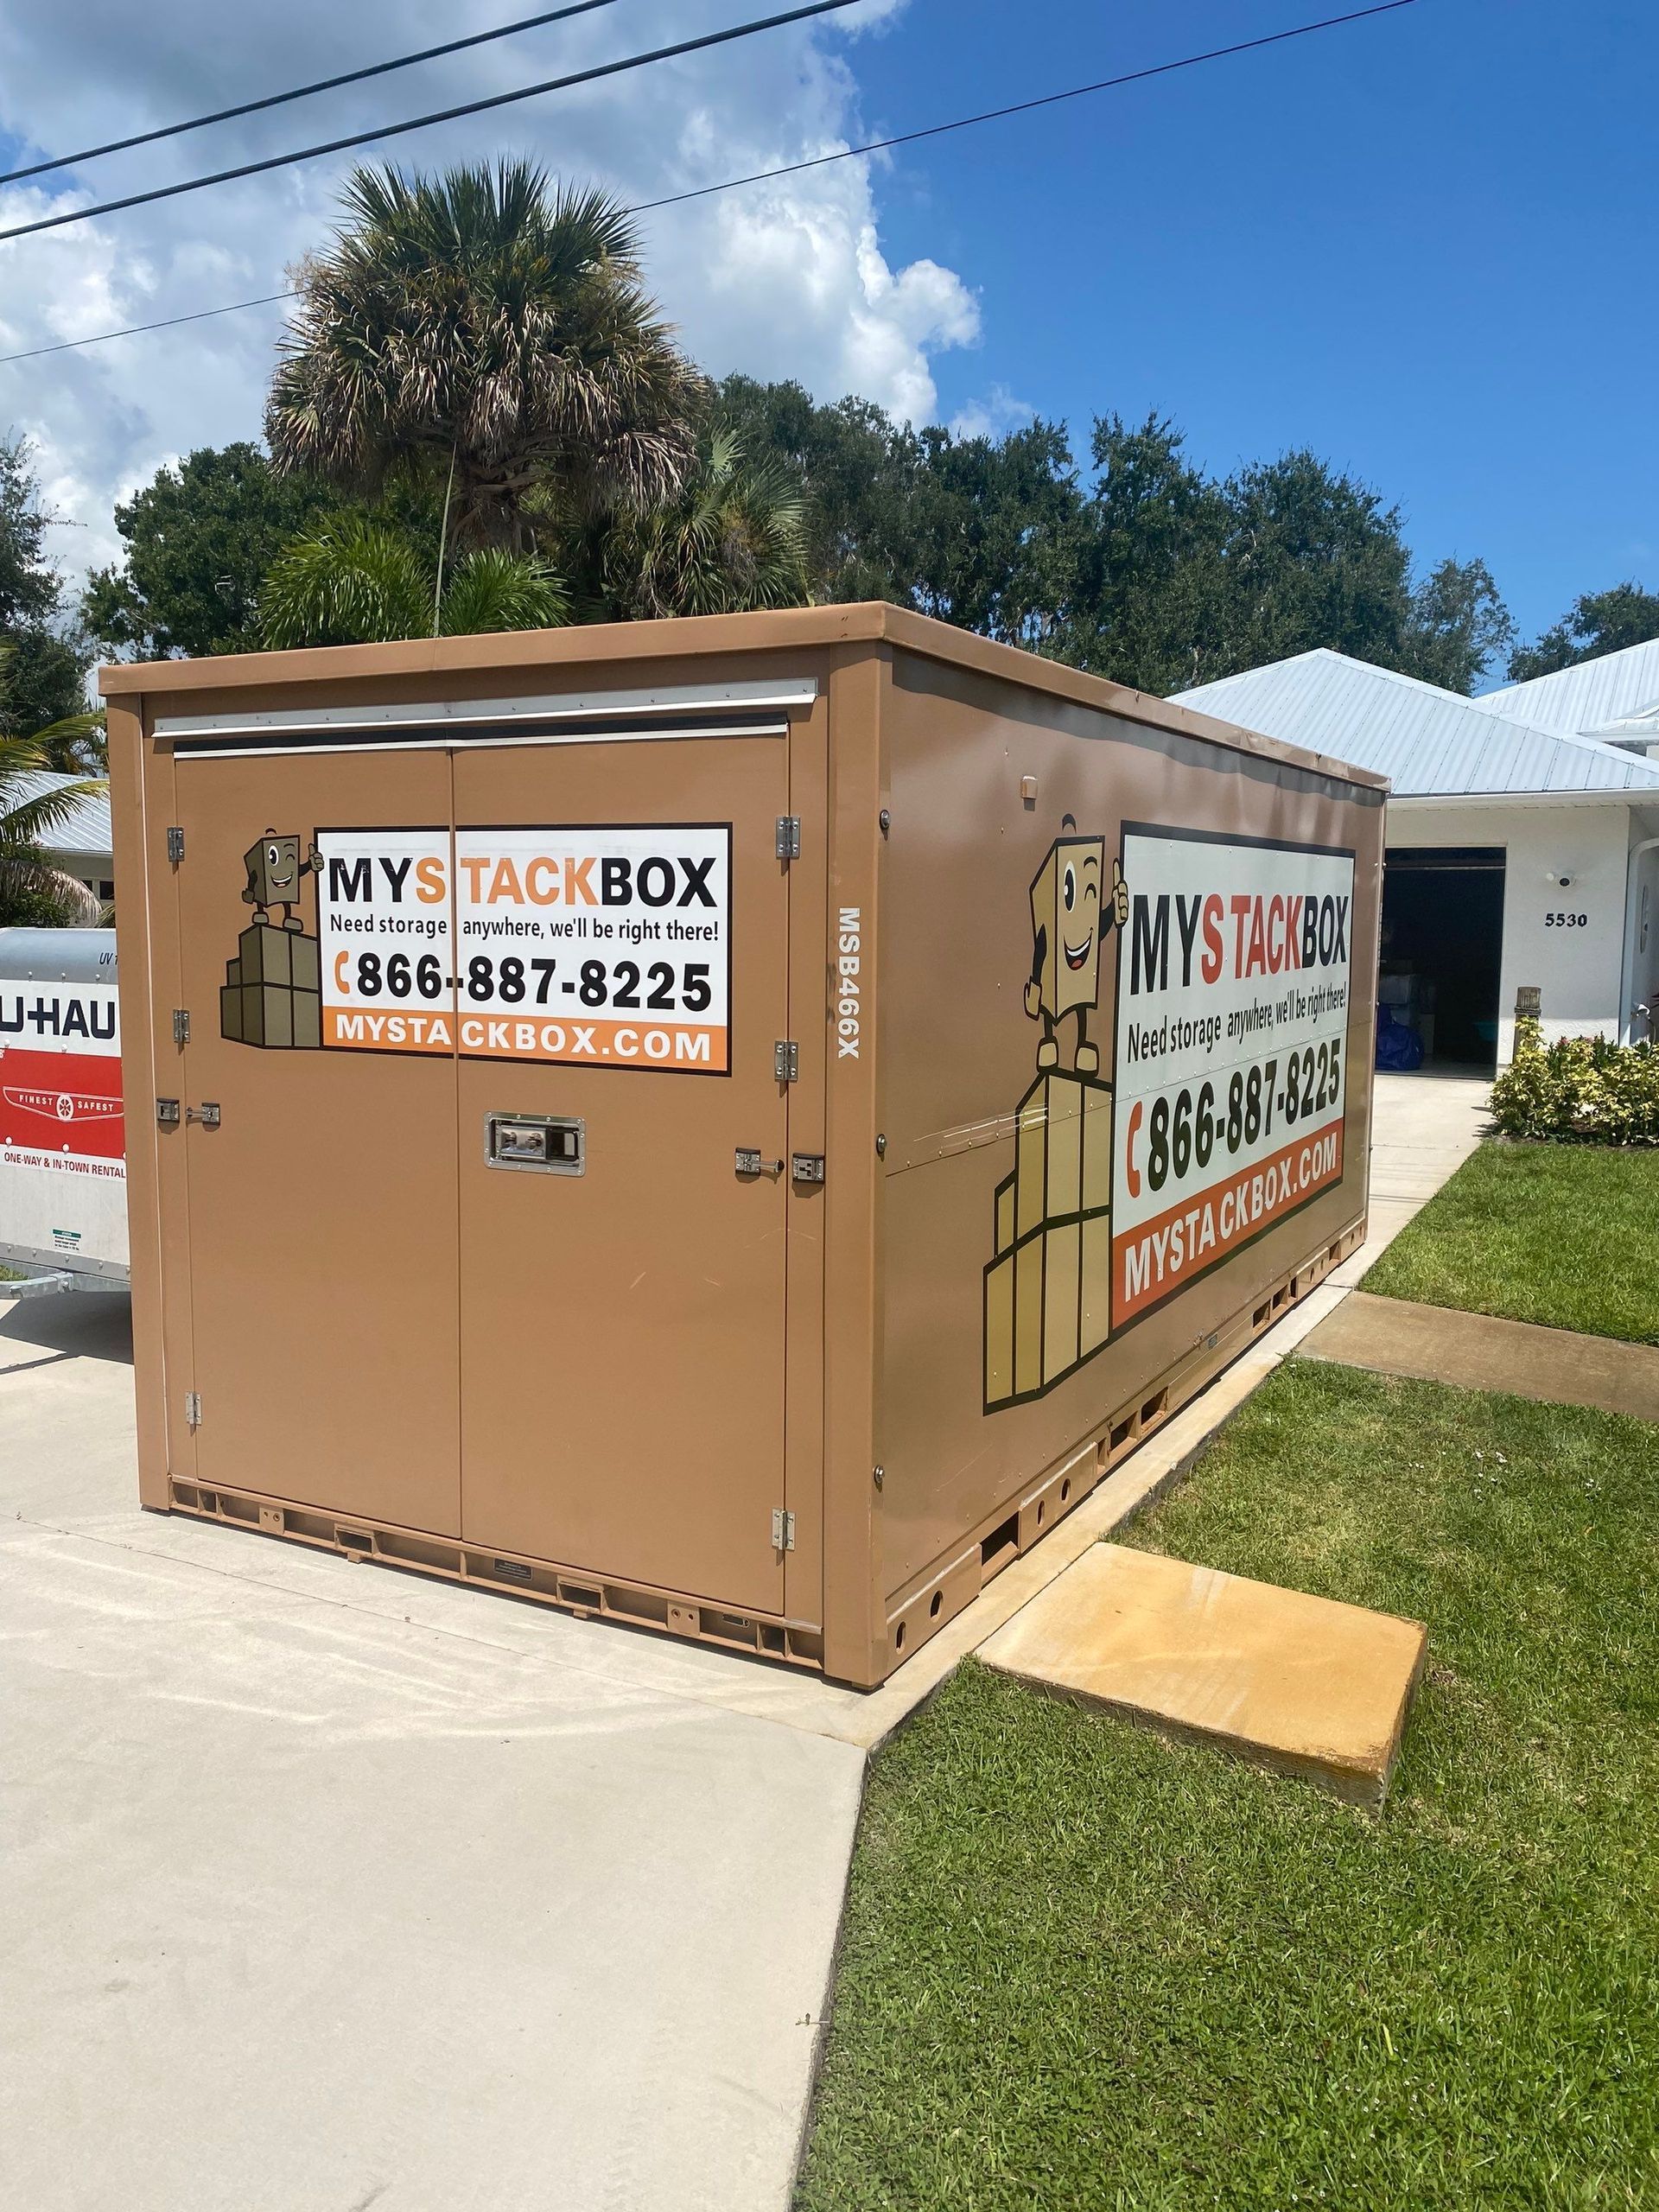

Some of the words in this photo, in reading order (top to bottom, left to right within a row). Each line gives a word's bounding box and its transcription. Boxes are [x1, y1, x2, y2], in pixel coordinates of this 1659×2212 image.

[329, 856, 718, 907] MYSTACKBOX
[330, 913, 374, 932] Need
[378, 915, 448, 938] storage
[462, 916, 545, 941] anywhere,
[550, 918, 587, 938] we'll
[593, 918, 613, 938] be
[619, 918, 661, 945] right
[666, 919, 719, 941] there!
[1129, 893, 1350, 995] MYSTACKBOX
[1544, 912, 1588, 927] 5530
[99, 952, 114, 965] UV
[356, 952, 712, 1012] 866-887-8225
[837, 907, 861, 1059] MSB466X
[336, 1014, 711, 1062] MYSTACKBOX.COM
[1128, 1014, 1167, 1064] Need
[1170, 1014, 1222, 1053] storage
[1227, 996, 1274, 1045] anywhere,
[1275, 988, 1294, 1025] we'll
[1296, 988, 1306, 1019] be
[1307, 984, 1326, 1024] right
[1326, 980, 1347, 1012] there!
[19, 1094, 54, 1106] FINEST
[77, 1100, 114, 1112] SAFEST
[1147, 1037, 1342, 1192] 866-887-8225
[3, 1152, 42, 1166] ONE-WAY
[43, 1157, 50, 1168] &
[53, 1159, 90, 1174] IN-TOWN
[1124, 1131, 1338, 1304] MYSTACKBOX.COM
